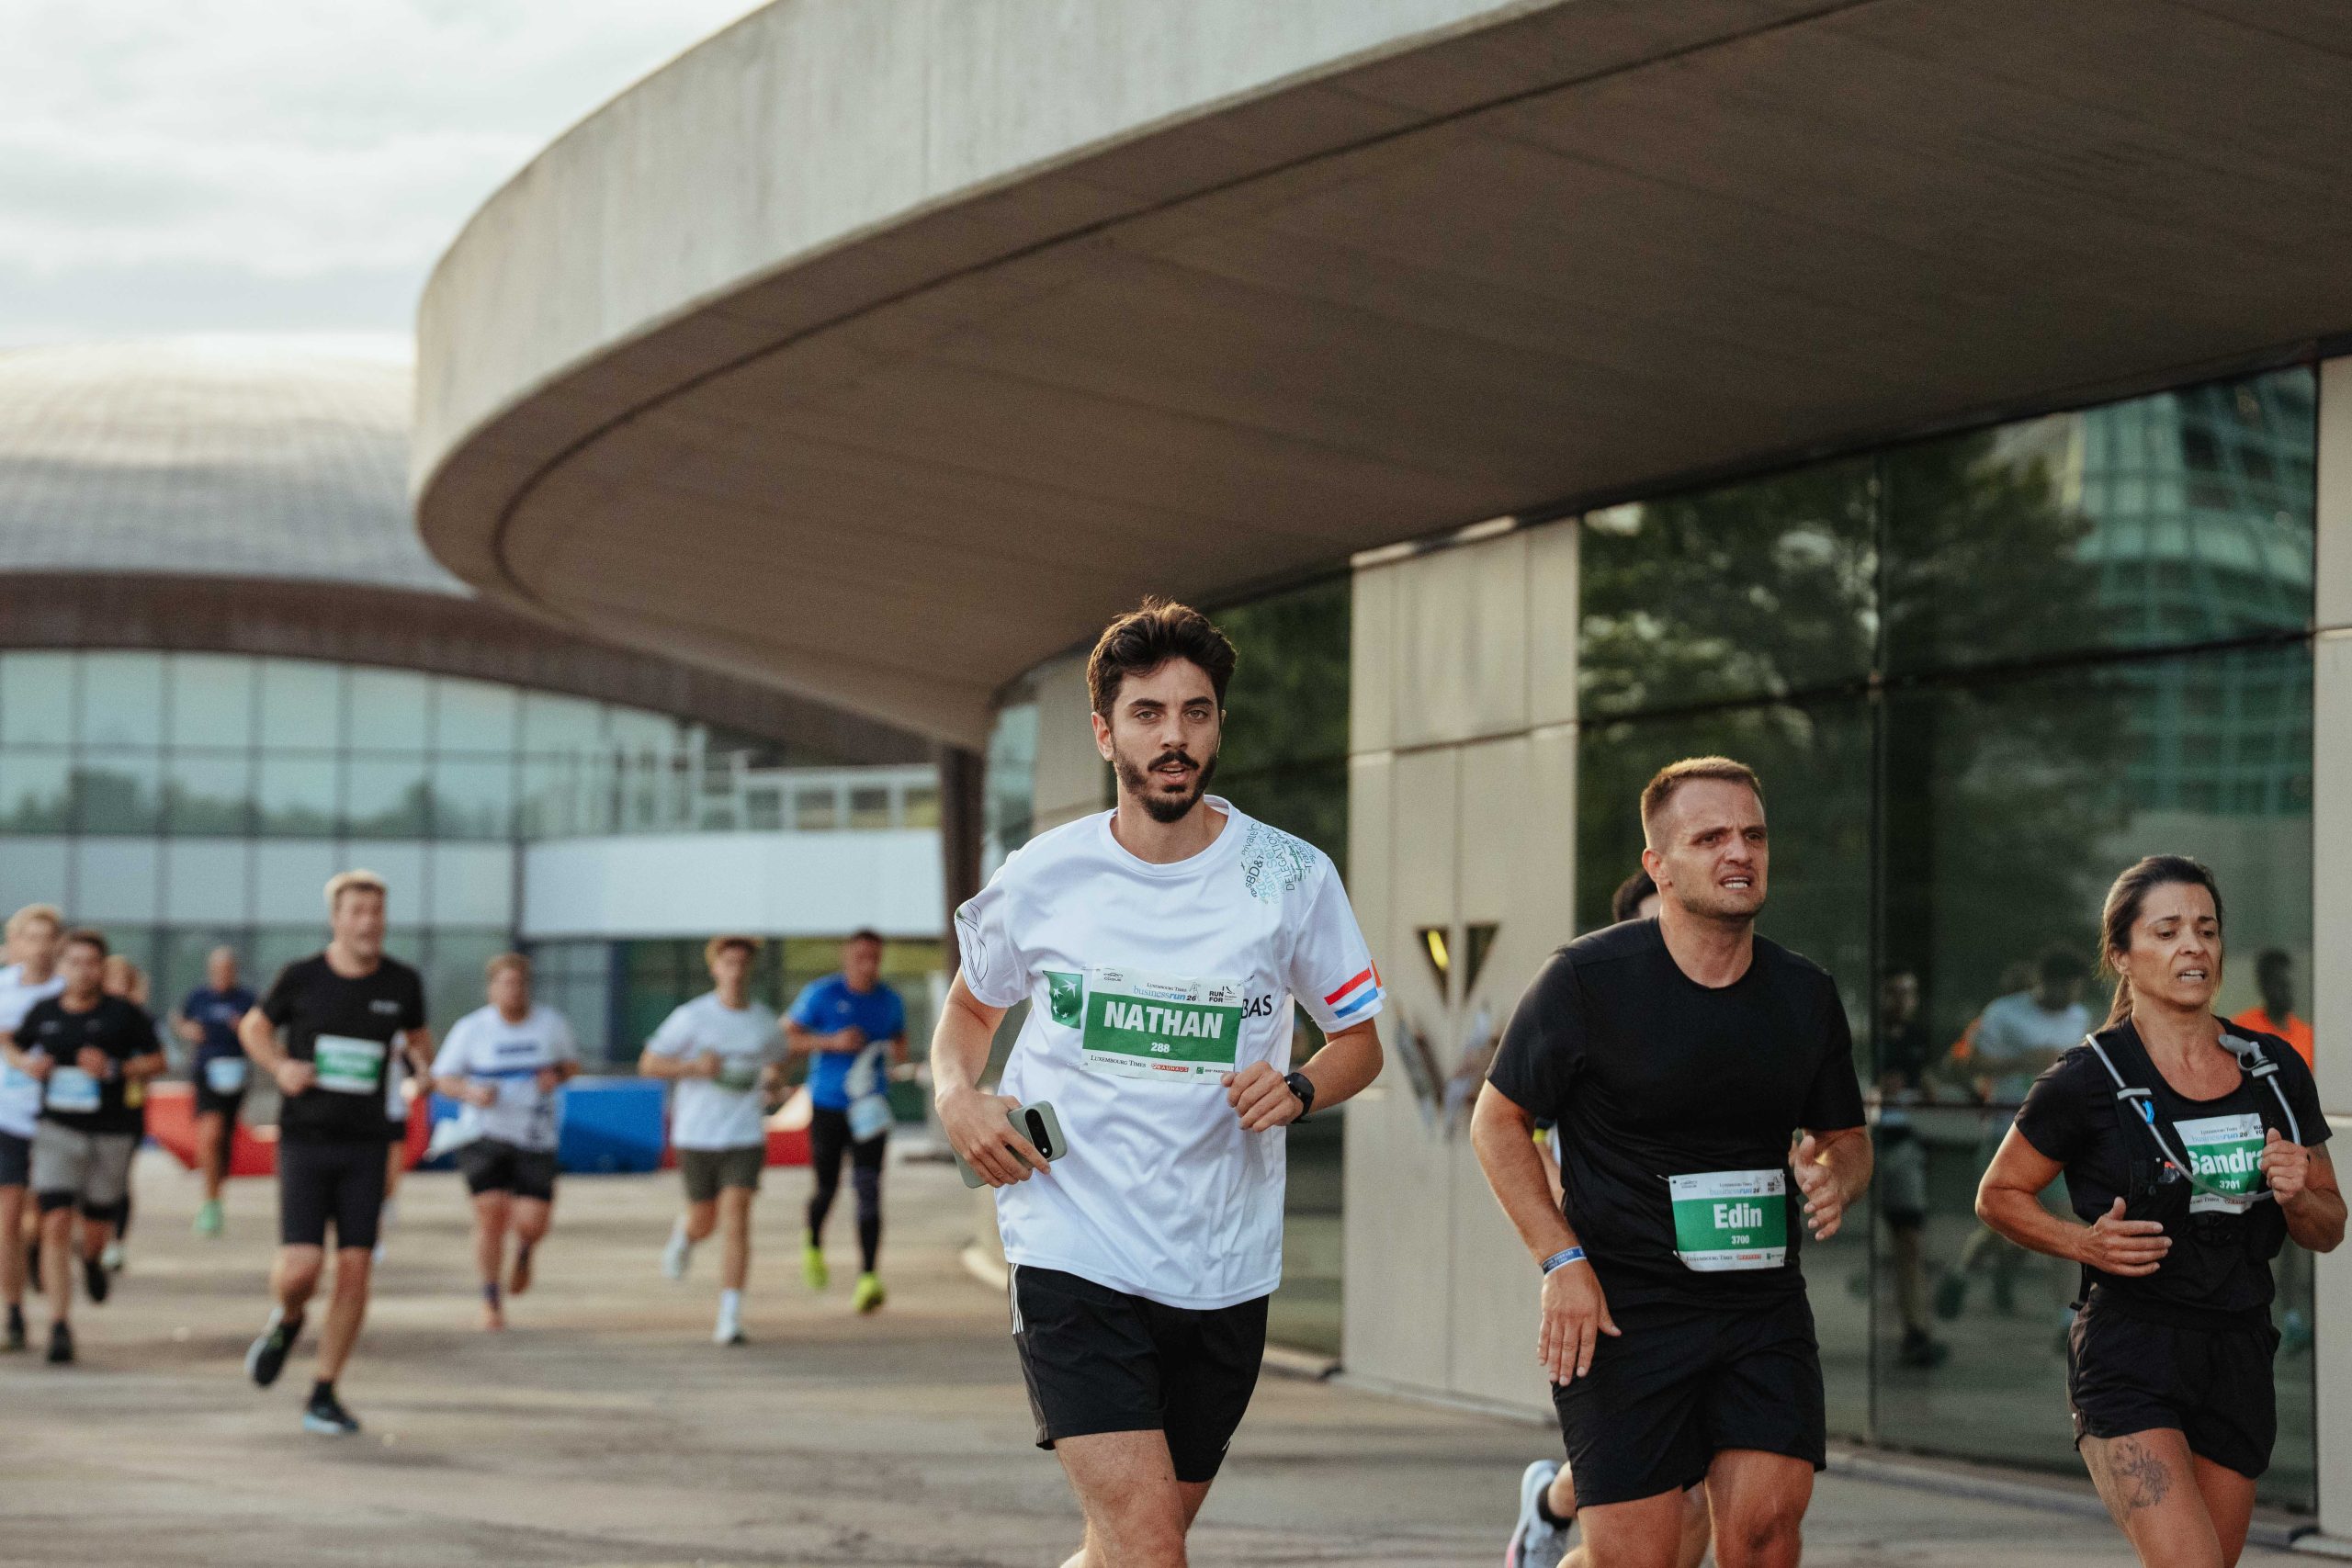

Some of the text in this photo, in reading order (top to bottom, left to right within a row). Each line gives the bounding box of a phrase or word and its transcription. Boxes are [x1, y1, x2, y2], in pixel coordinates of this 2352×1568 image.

[1267, 833, 1295, 891] DELEGATION
[1103, 1000, 1224, 1039] NATHAN
[1150, 1042, 1170, 1054] 288
[1091, 1055, 1147, 1068] LUXEMBOURG TIMES
[2219, 1179, 2241, 1190] 3701
[1713, 1202, 1763, 1229] Edin
[1731, 1235, 1750, 1245] 3700
